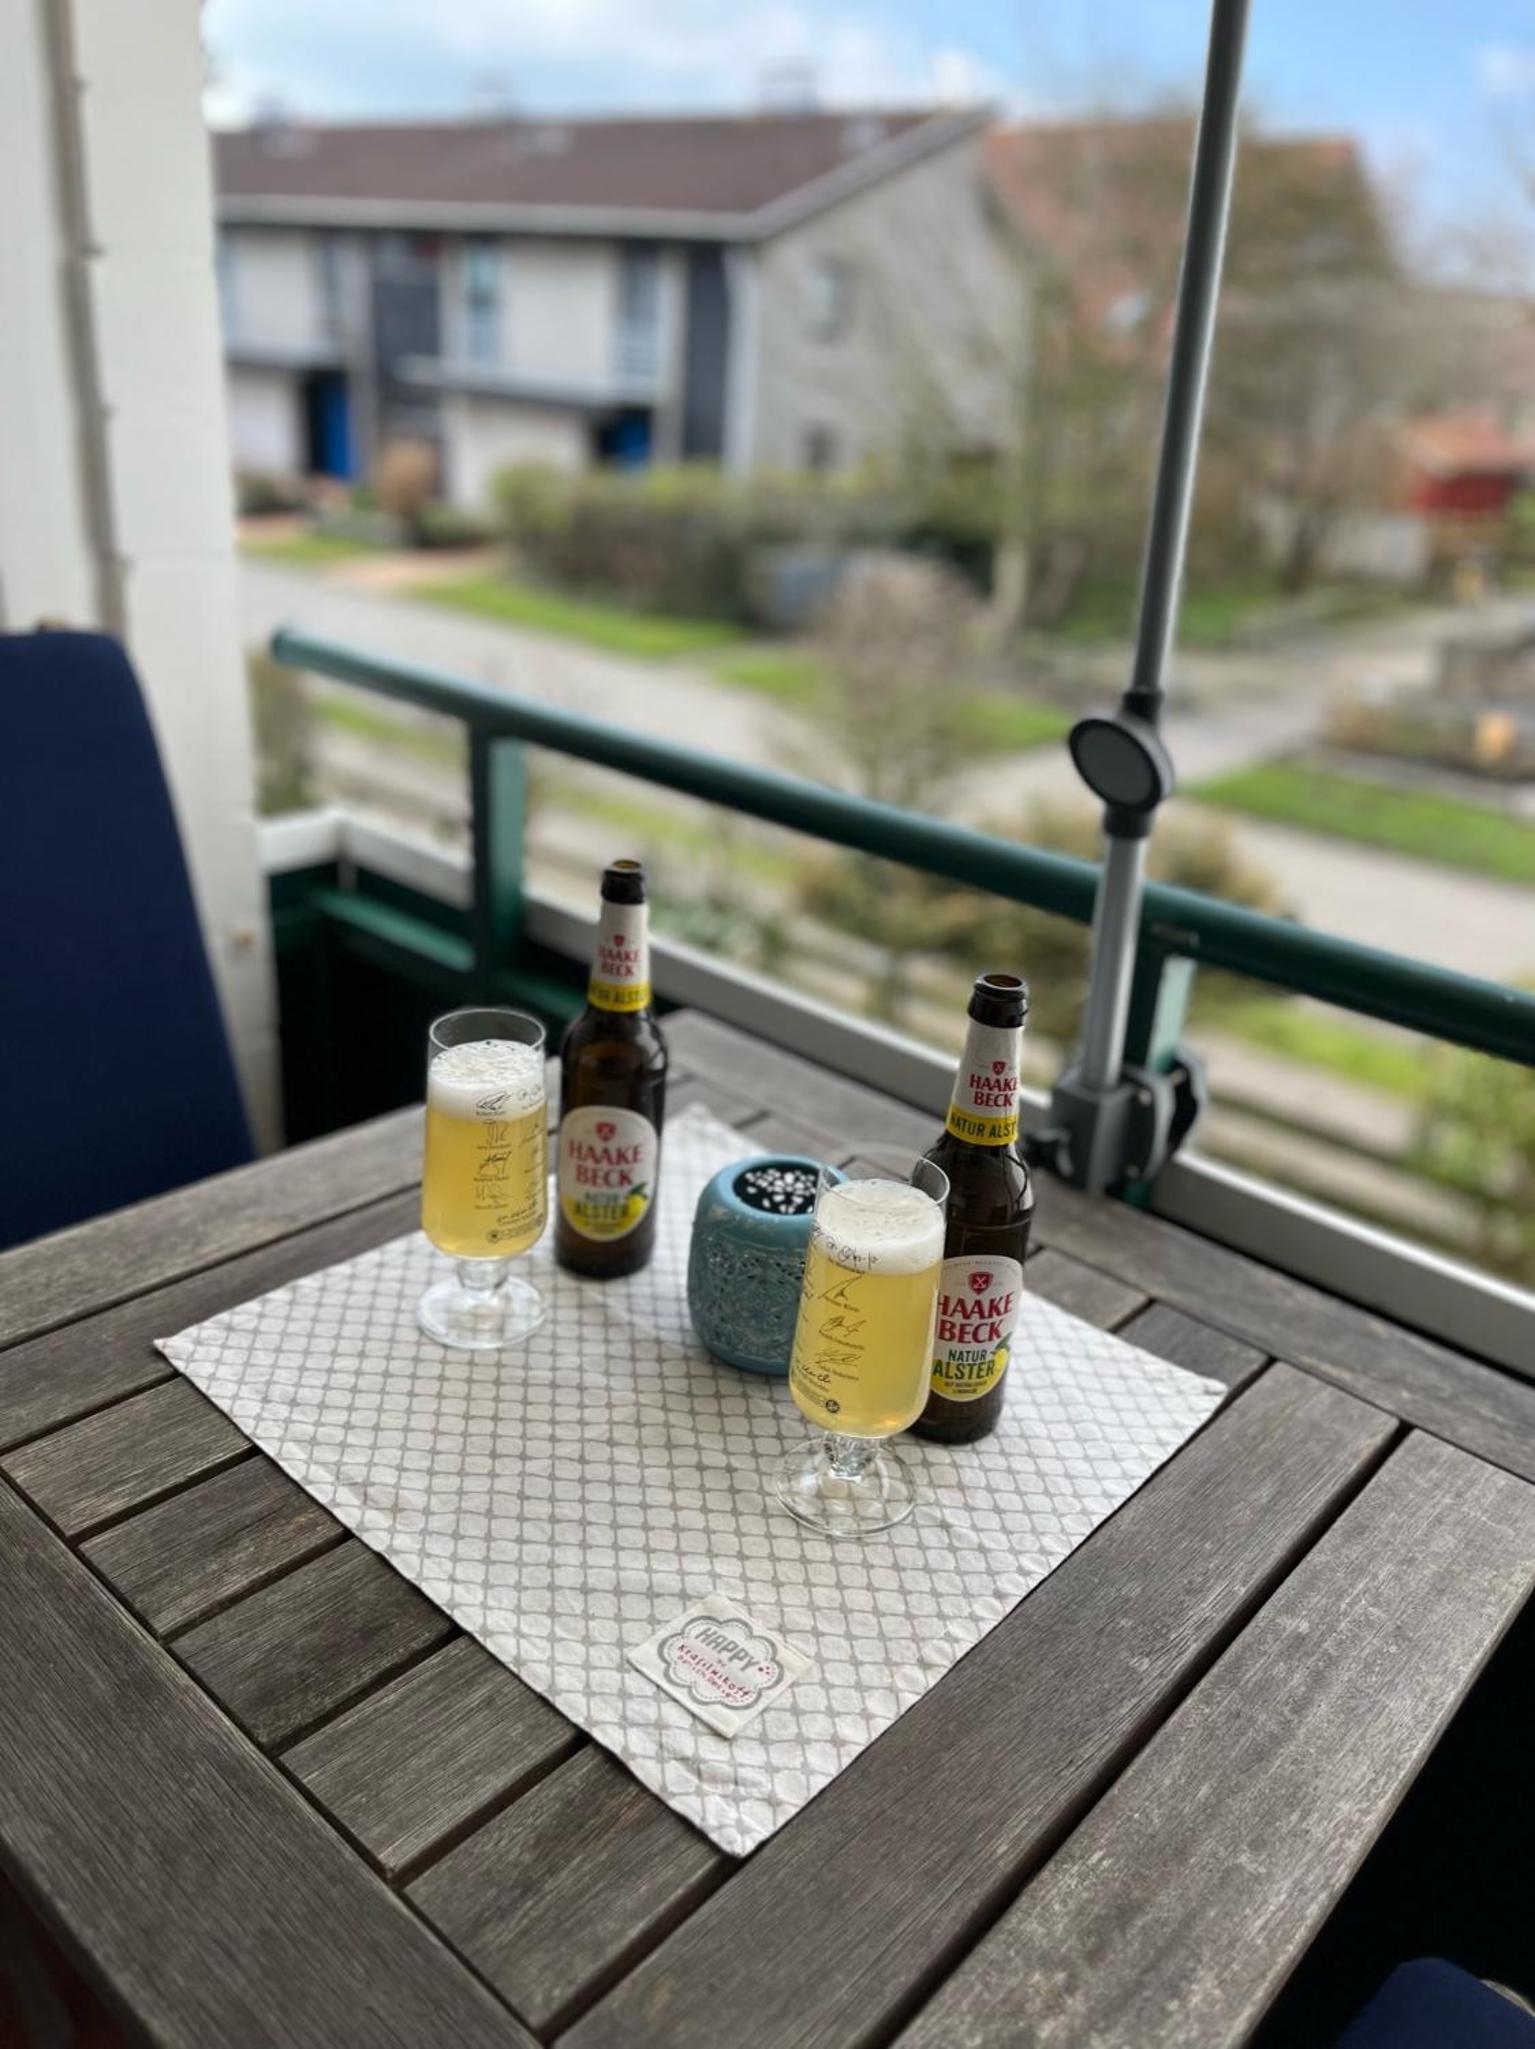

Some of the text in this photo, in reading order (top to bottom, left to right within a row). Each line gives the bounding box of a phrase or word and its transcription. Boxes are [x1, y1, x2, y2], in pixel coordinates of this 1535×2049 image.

[598, 945, 640, 962] HAAKE
[602, 962, 634, 977] BECK
[974, 1091, 1013, 1107] BECK
[567, 1139, 644, 1166] HAAKE
[575, 1163, 634, 1188] BECK
[937, 1291, 1015, 1320] HAAKE
[938, 1319, 1003, 1344] BECK
[948, 1349, 988, 1363] NATUR
[932, 1359, 996, 1380] ALSTER
[694, 1627, 760, 1672] HAPPY
